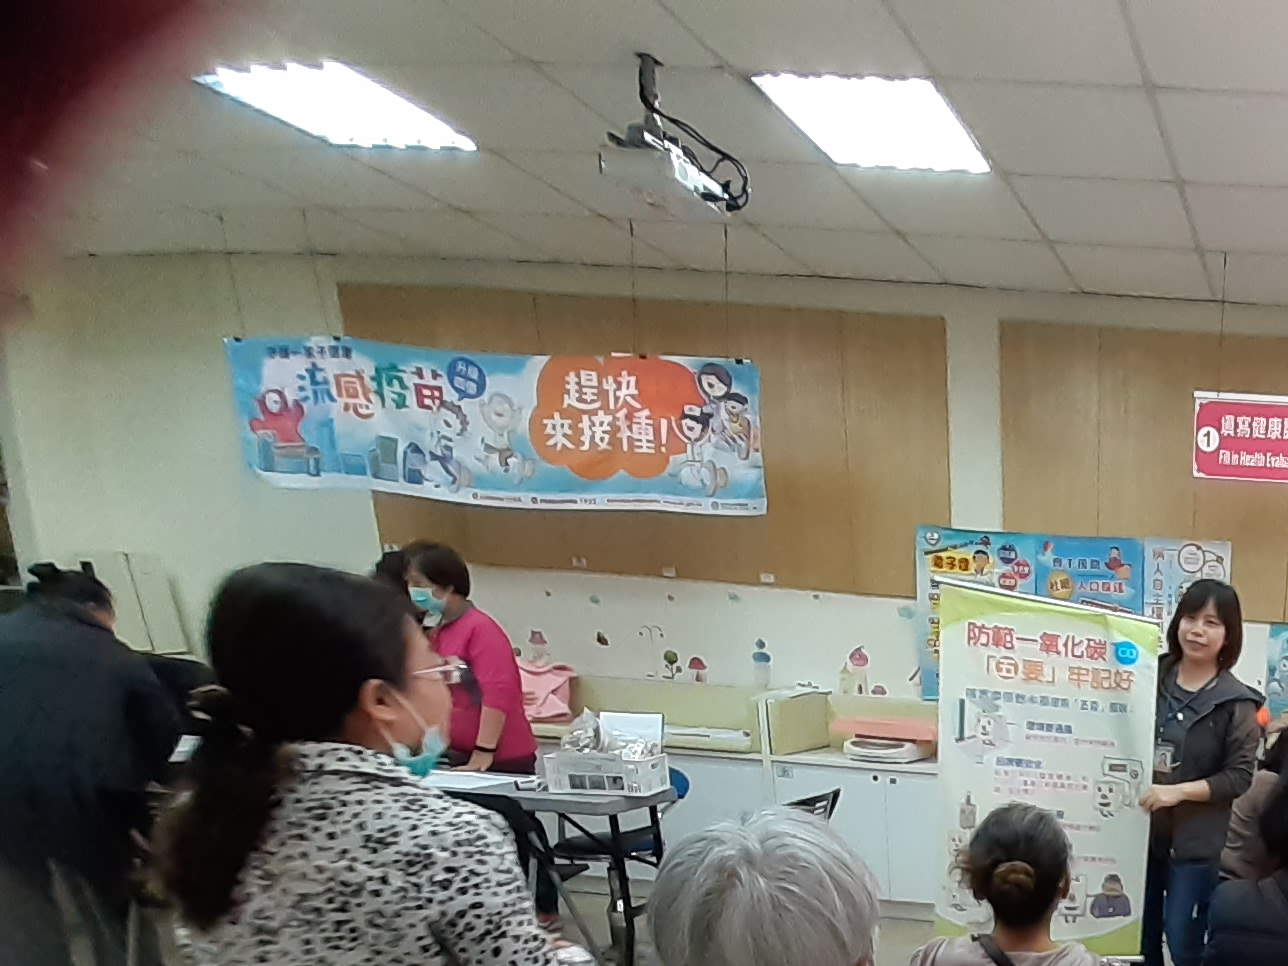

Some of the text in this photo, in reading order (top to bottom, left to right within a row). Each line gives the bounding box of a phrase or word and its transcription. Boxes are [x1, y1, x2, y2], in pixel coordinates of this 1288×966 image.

[296, 361, 444, 421] 流感疫苗
[564, 370, 642, 410] 趕快
[1239, 452, 1266, 467] Health
[966, 621, 1108, 662] 防範一氧化碳
[1067, 665, 1135, 692] 牢記好
